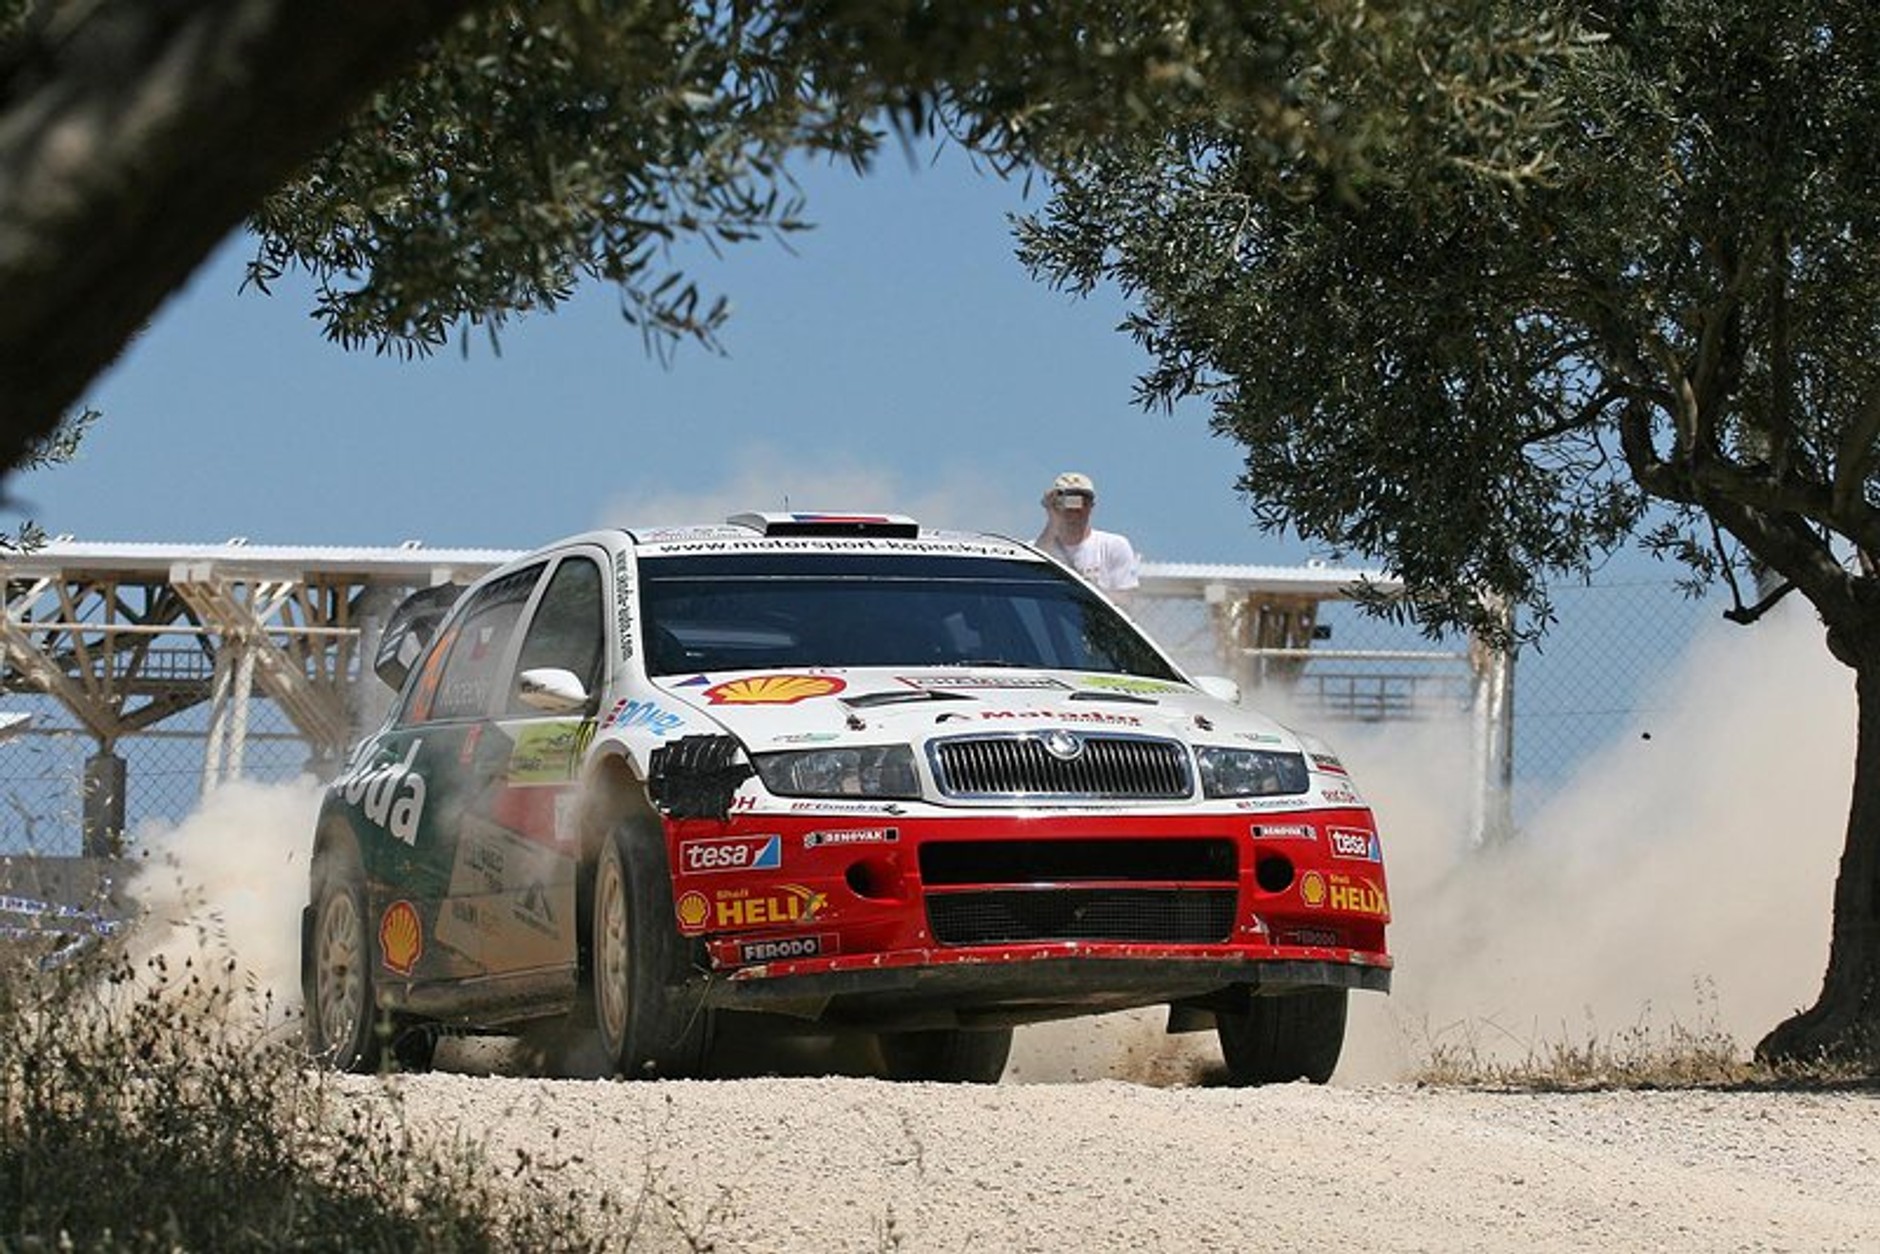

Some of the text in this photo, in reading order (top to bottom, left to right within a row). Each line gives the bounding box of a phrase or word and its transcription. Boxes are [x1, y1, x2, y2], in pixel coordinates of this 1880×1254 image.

[1333, 831, 1366, 855] tesa
[687, 844, 748, 868] tesa
[1330, 885, 1389, 915] HELIX
[744, 939, 816, 960] FERODO
